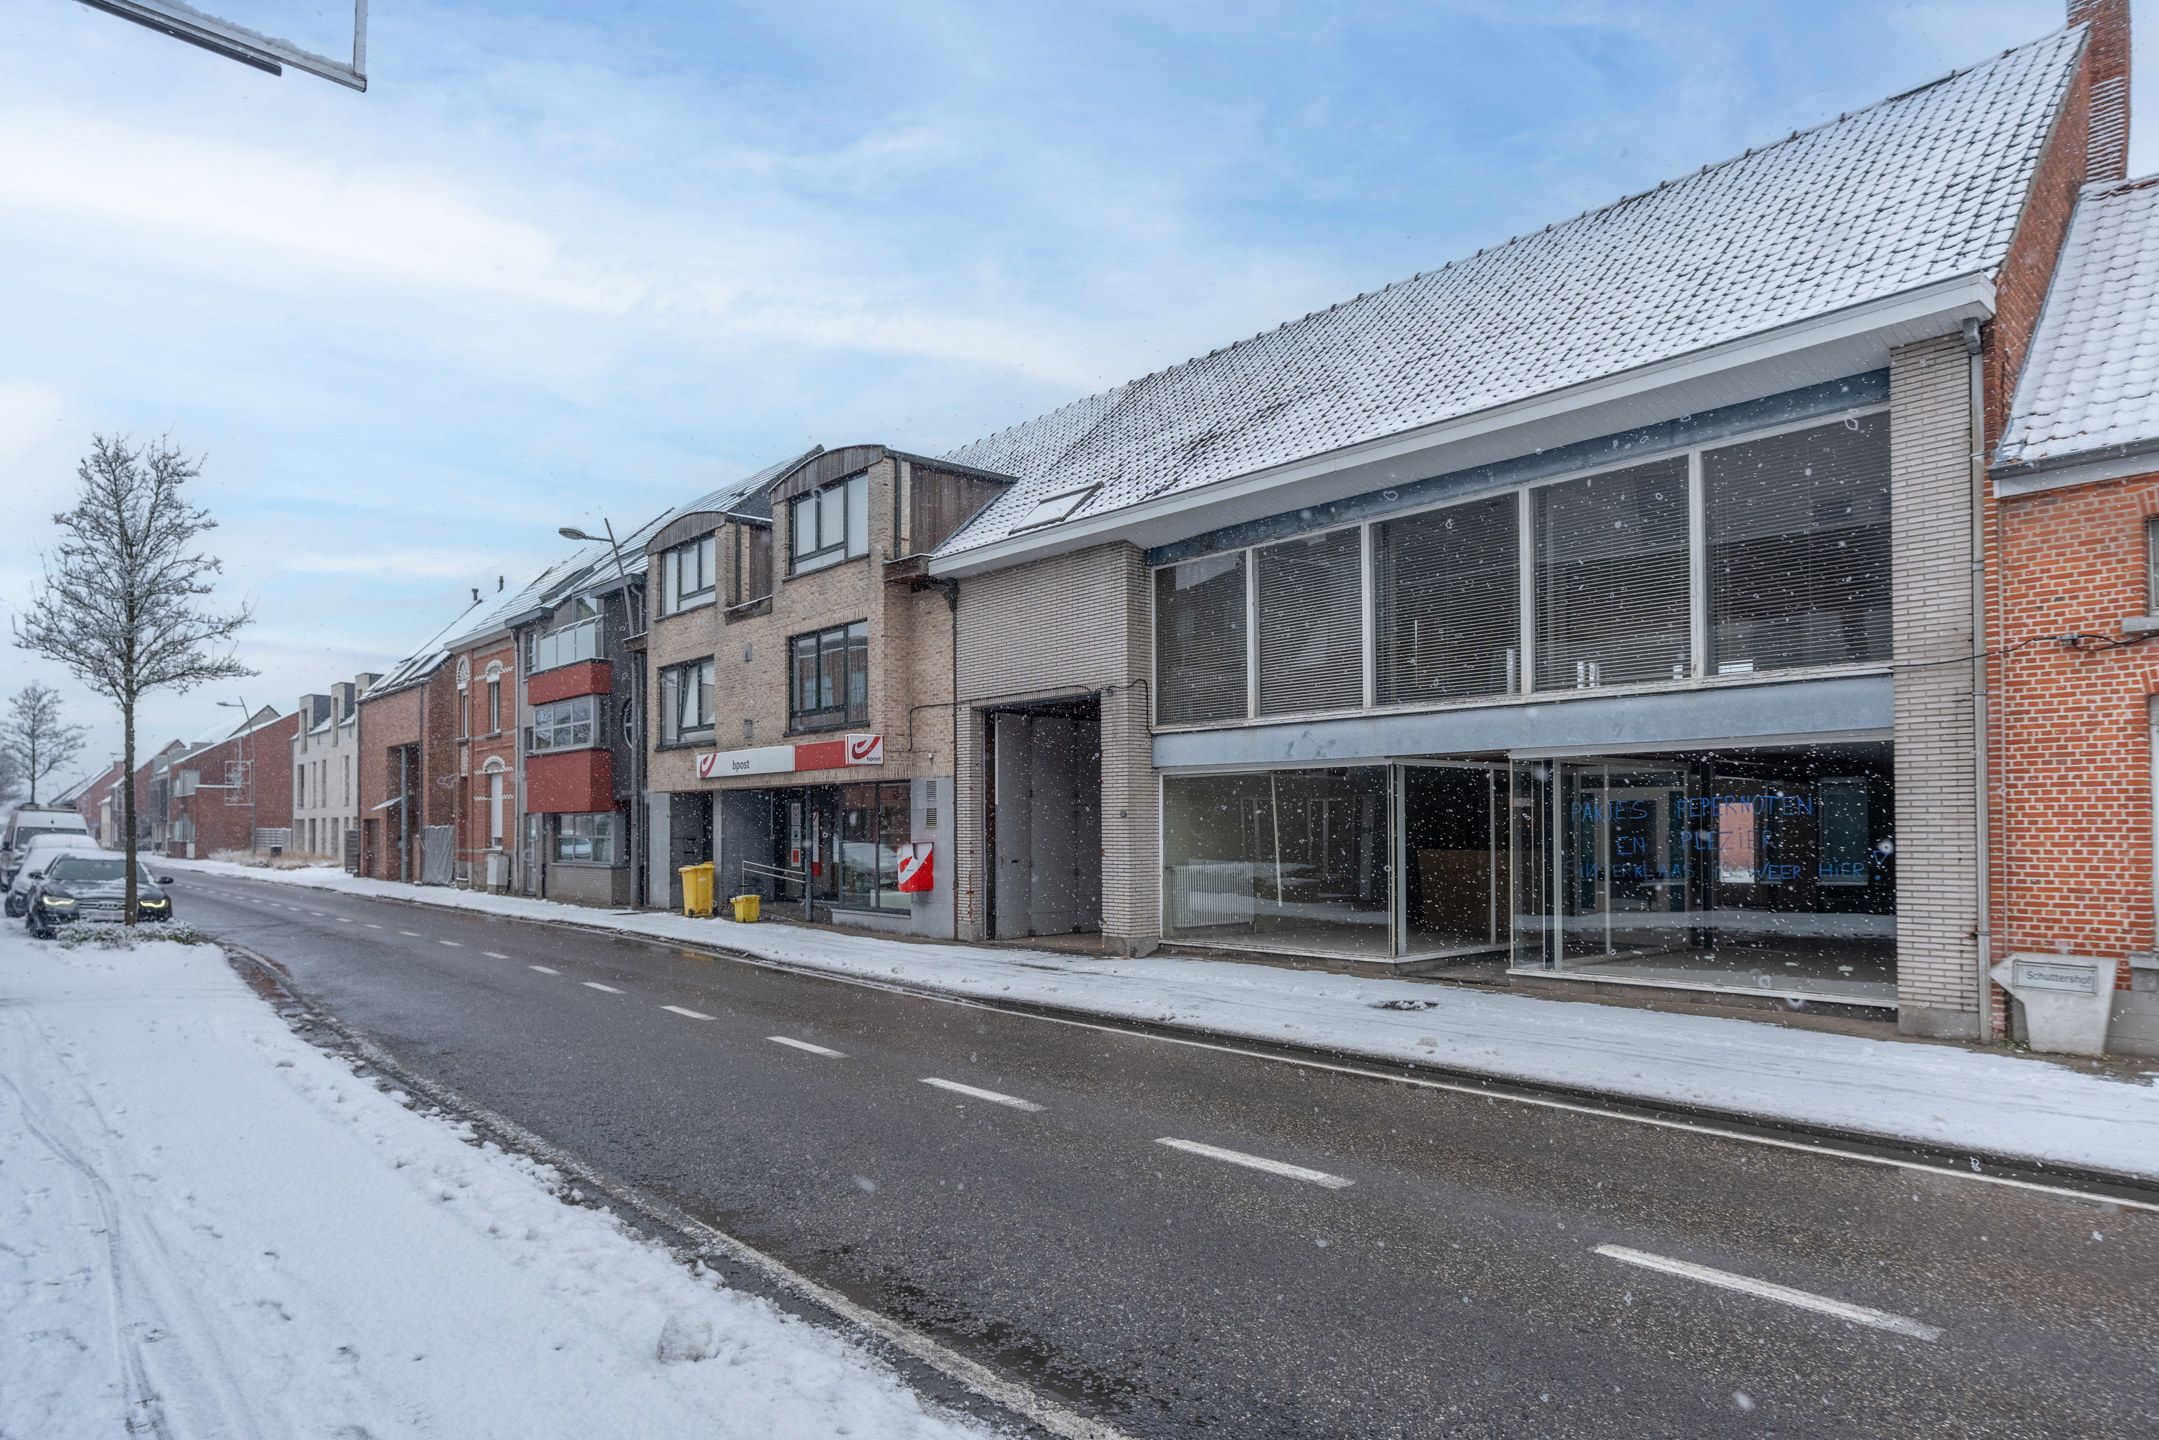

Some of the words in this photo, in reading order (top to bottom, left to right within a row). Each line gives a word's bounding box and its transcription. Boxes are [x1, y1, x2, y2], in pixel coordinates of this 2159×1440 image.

[732, 760, 750, 771] bpost
[1571, 800, 1648, 822] PAKJES
[1677, 795, 1813, 818] PEPERNOTEN
[1616, 835, 1646, 855] EN
[1747, 861, 1802, 880] WEER
[2026, 970, 2091, 984] Schuttershof
